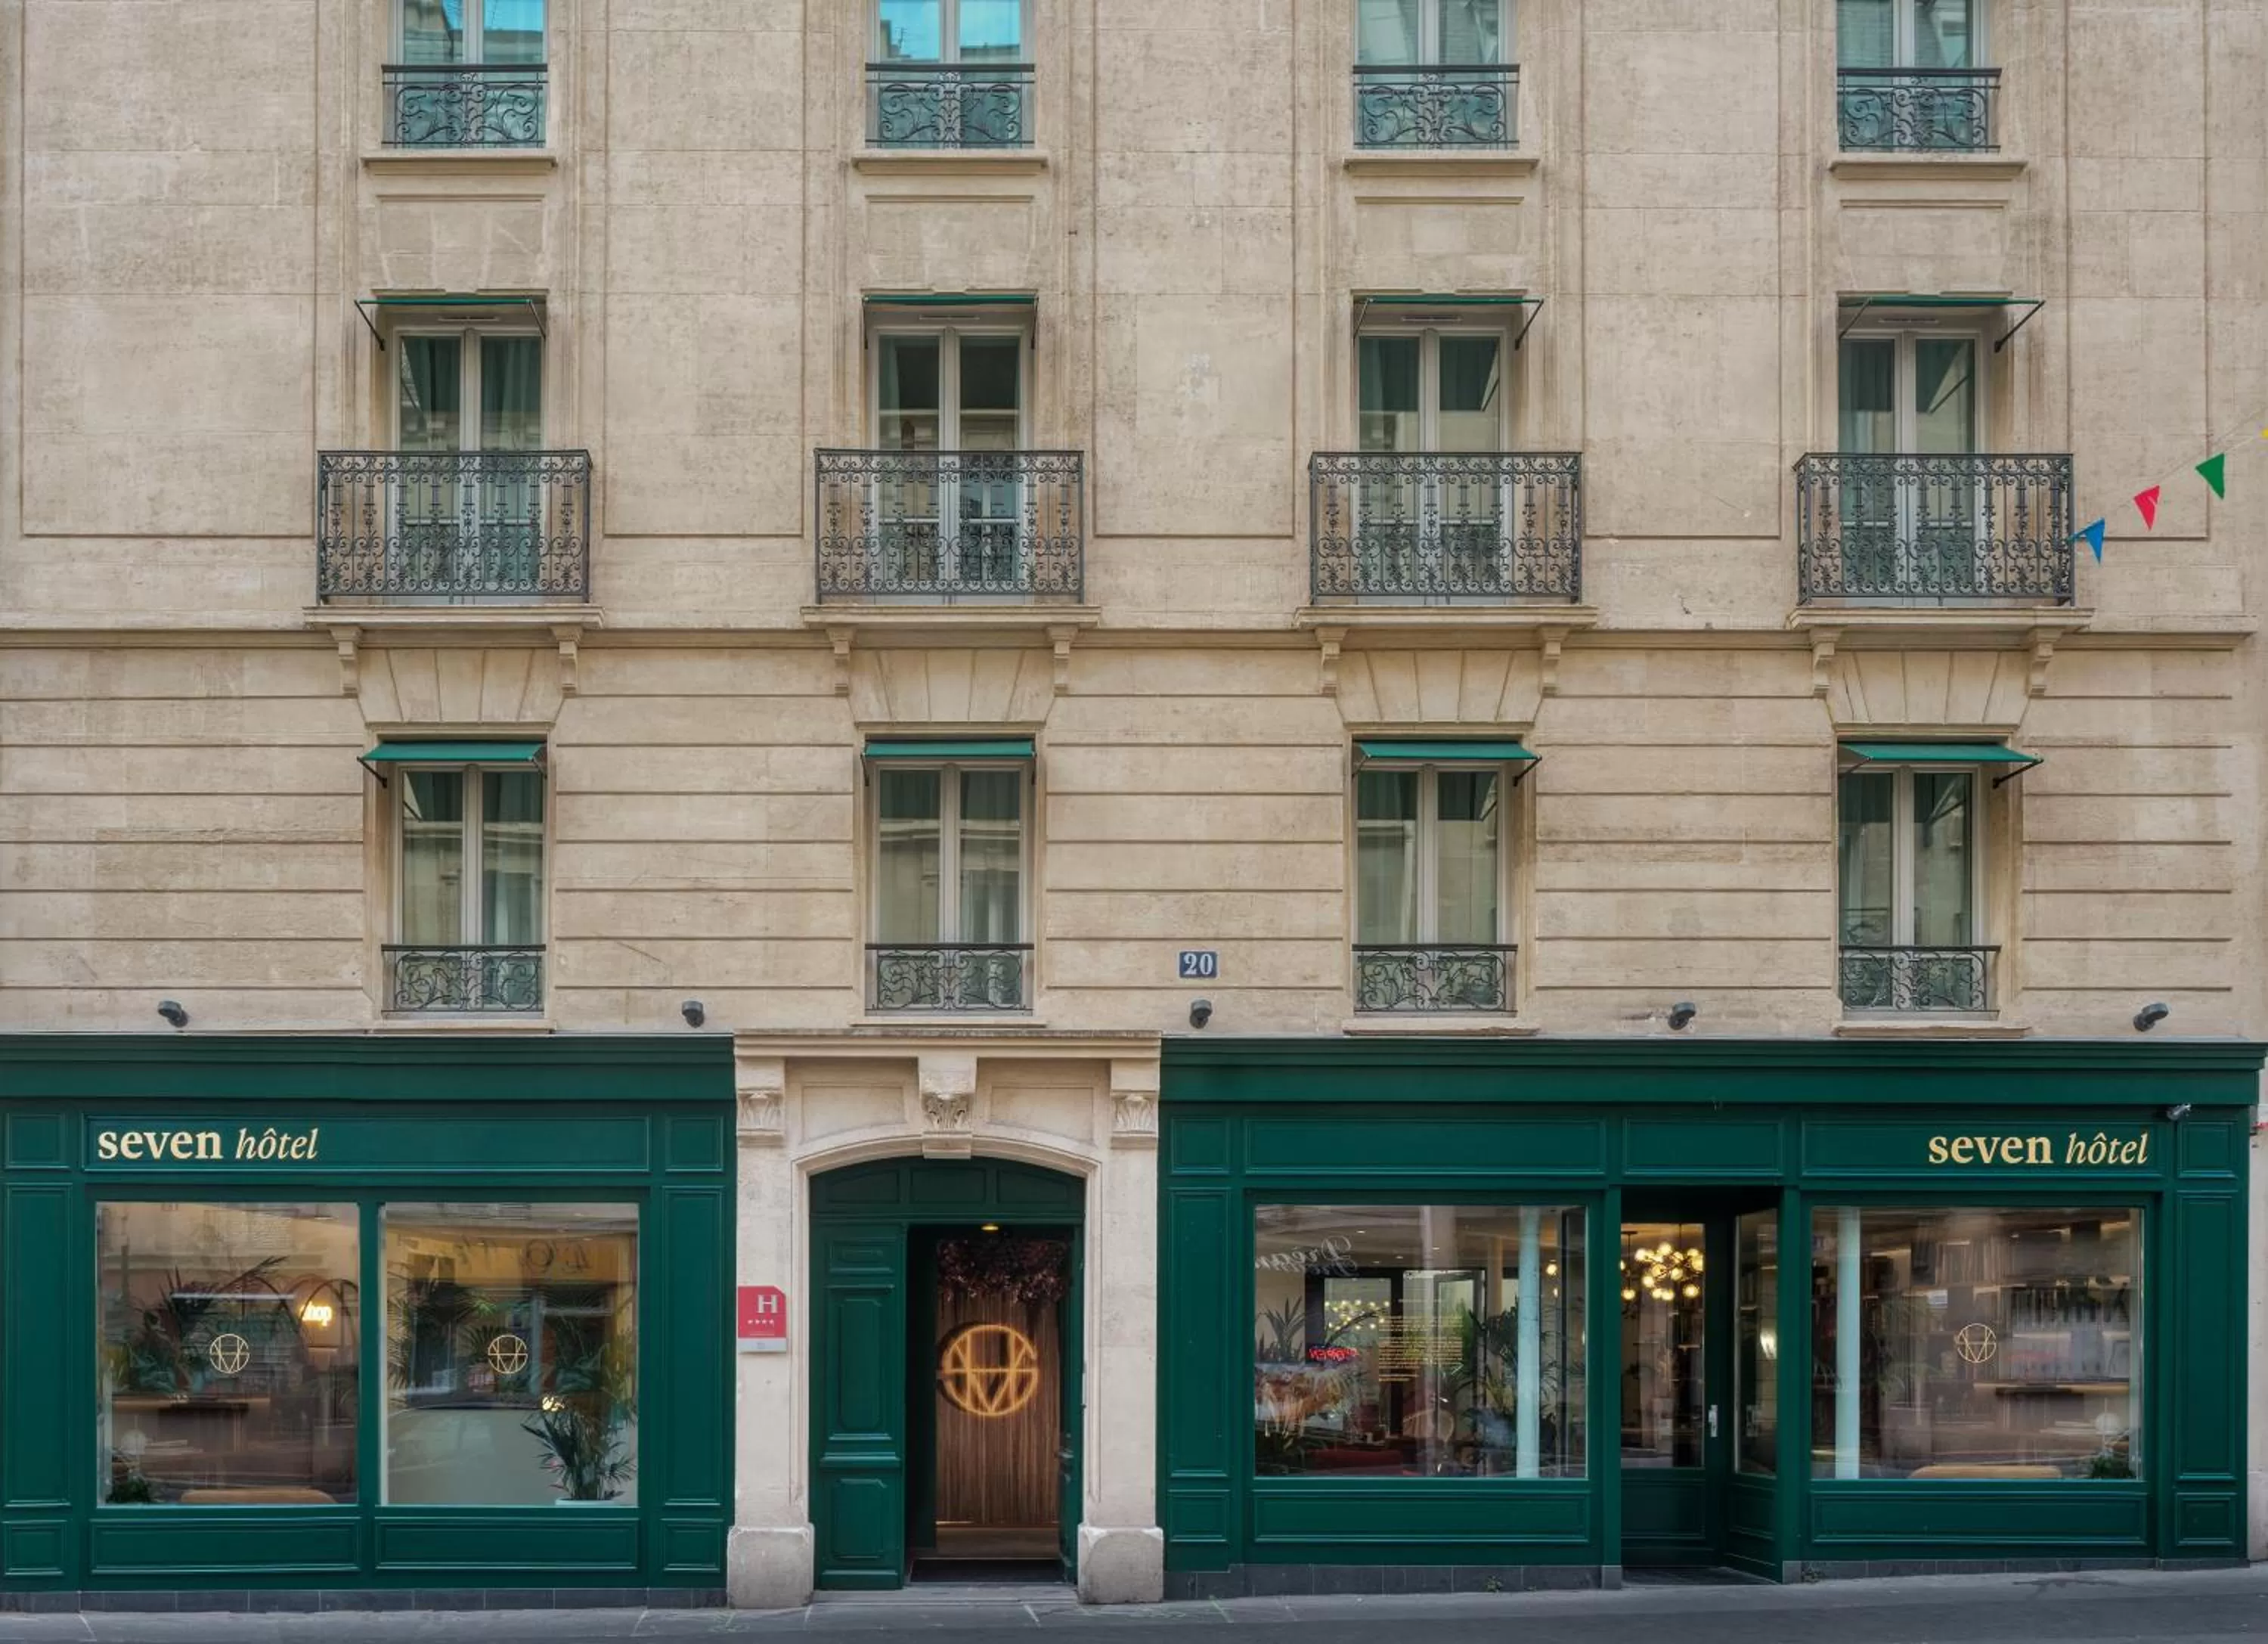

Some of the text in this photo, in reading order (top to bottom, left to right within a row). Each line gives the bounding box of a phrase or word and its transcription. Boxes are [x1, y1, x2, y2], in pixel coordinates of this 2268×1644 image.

[1183, 953, 1213, 976] 20
[98, 1128, 319, 1160] seven hôtel
[1928, 1131, 2149, 1165] seven hôtel
[758, 1294, 779, 1314] H
